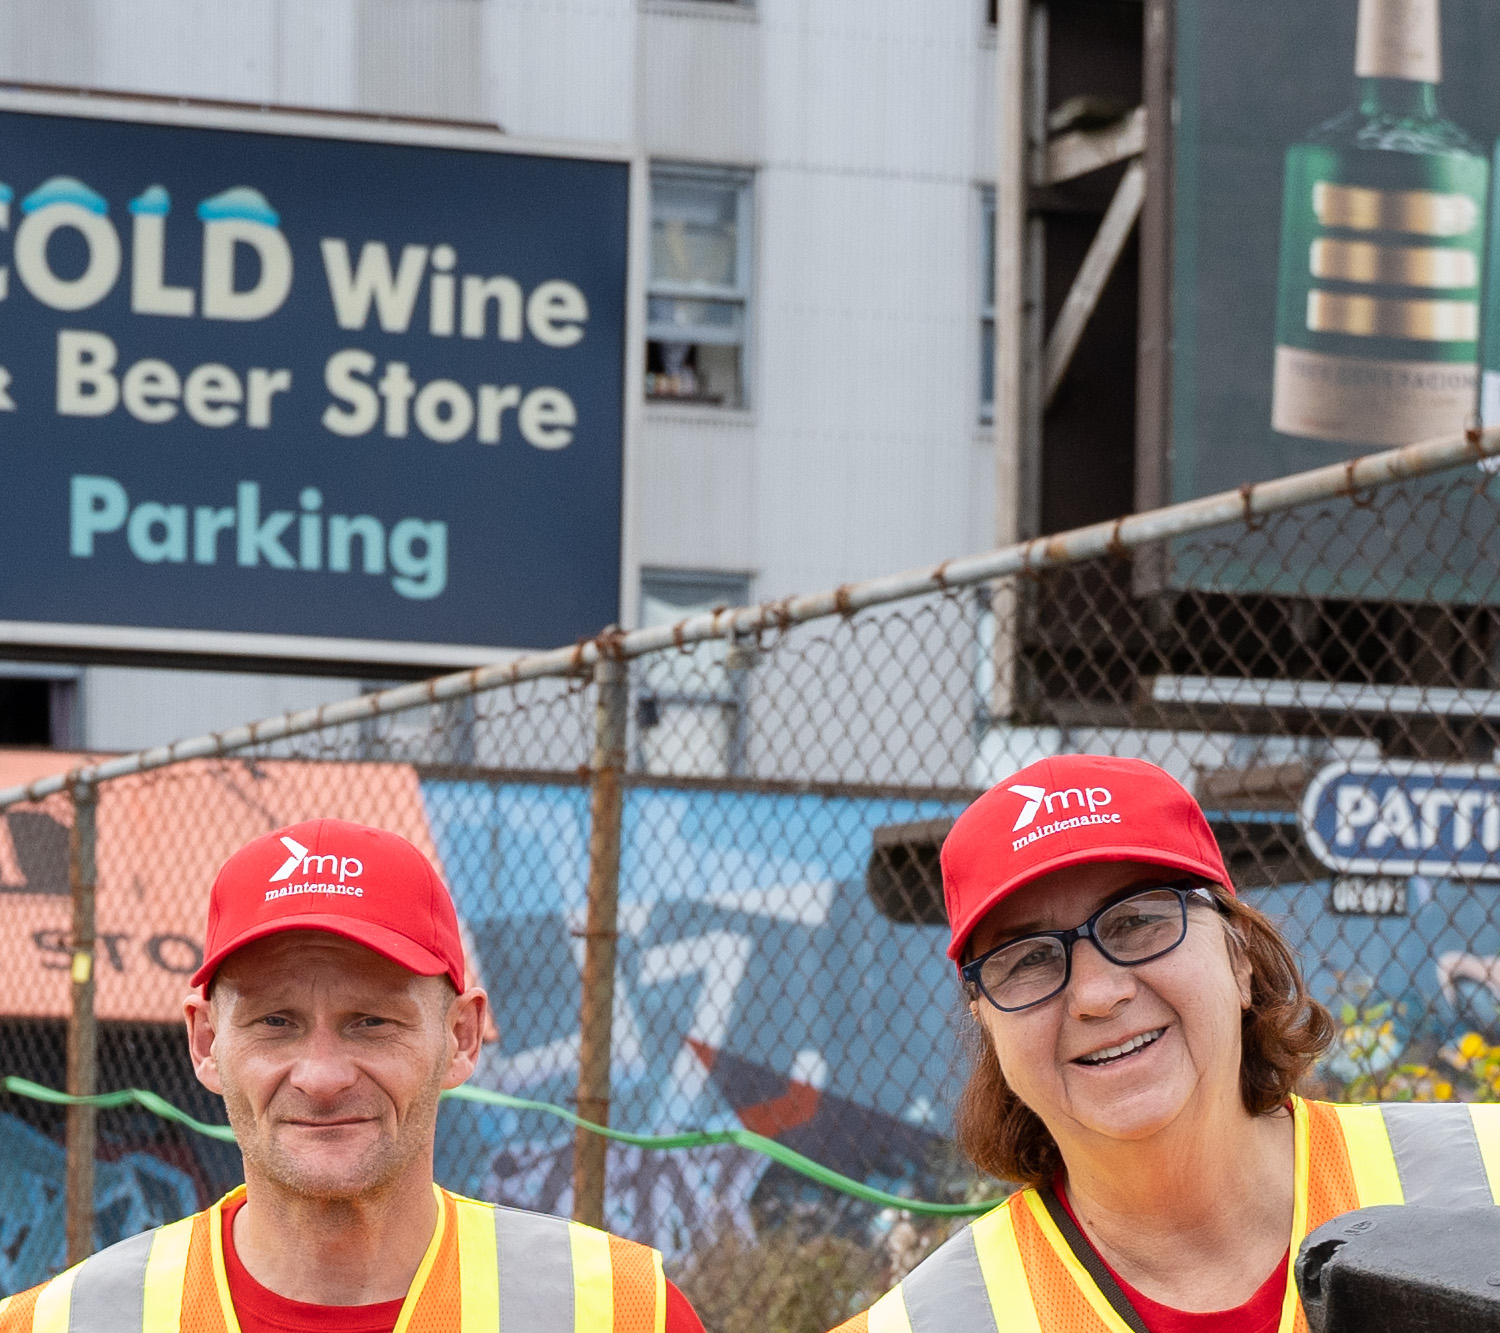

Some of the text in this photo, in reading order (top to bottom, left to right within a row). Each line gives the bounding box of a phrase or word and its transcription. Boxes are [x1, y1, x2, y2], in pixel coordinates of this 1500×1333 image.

[319, 237, 589, 347] Wine
[56, 329, 291, 430] Beer
[322, 348, 577, 450] Store
[69, 474, 449, 599] Parking
[1043, 786, 1113, 814] mp
[1011, 812, 1122, 851] maintenance
[302, 854, 364, 883] mp
[264, 880, 364, 902] maintenance
[32, 929, 203, 974] STO
